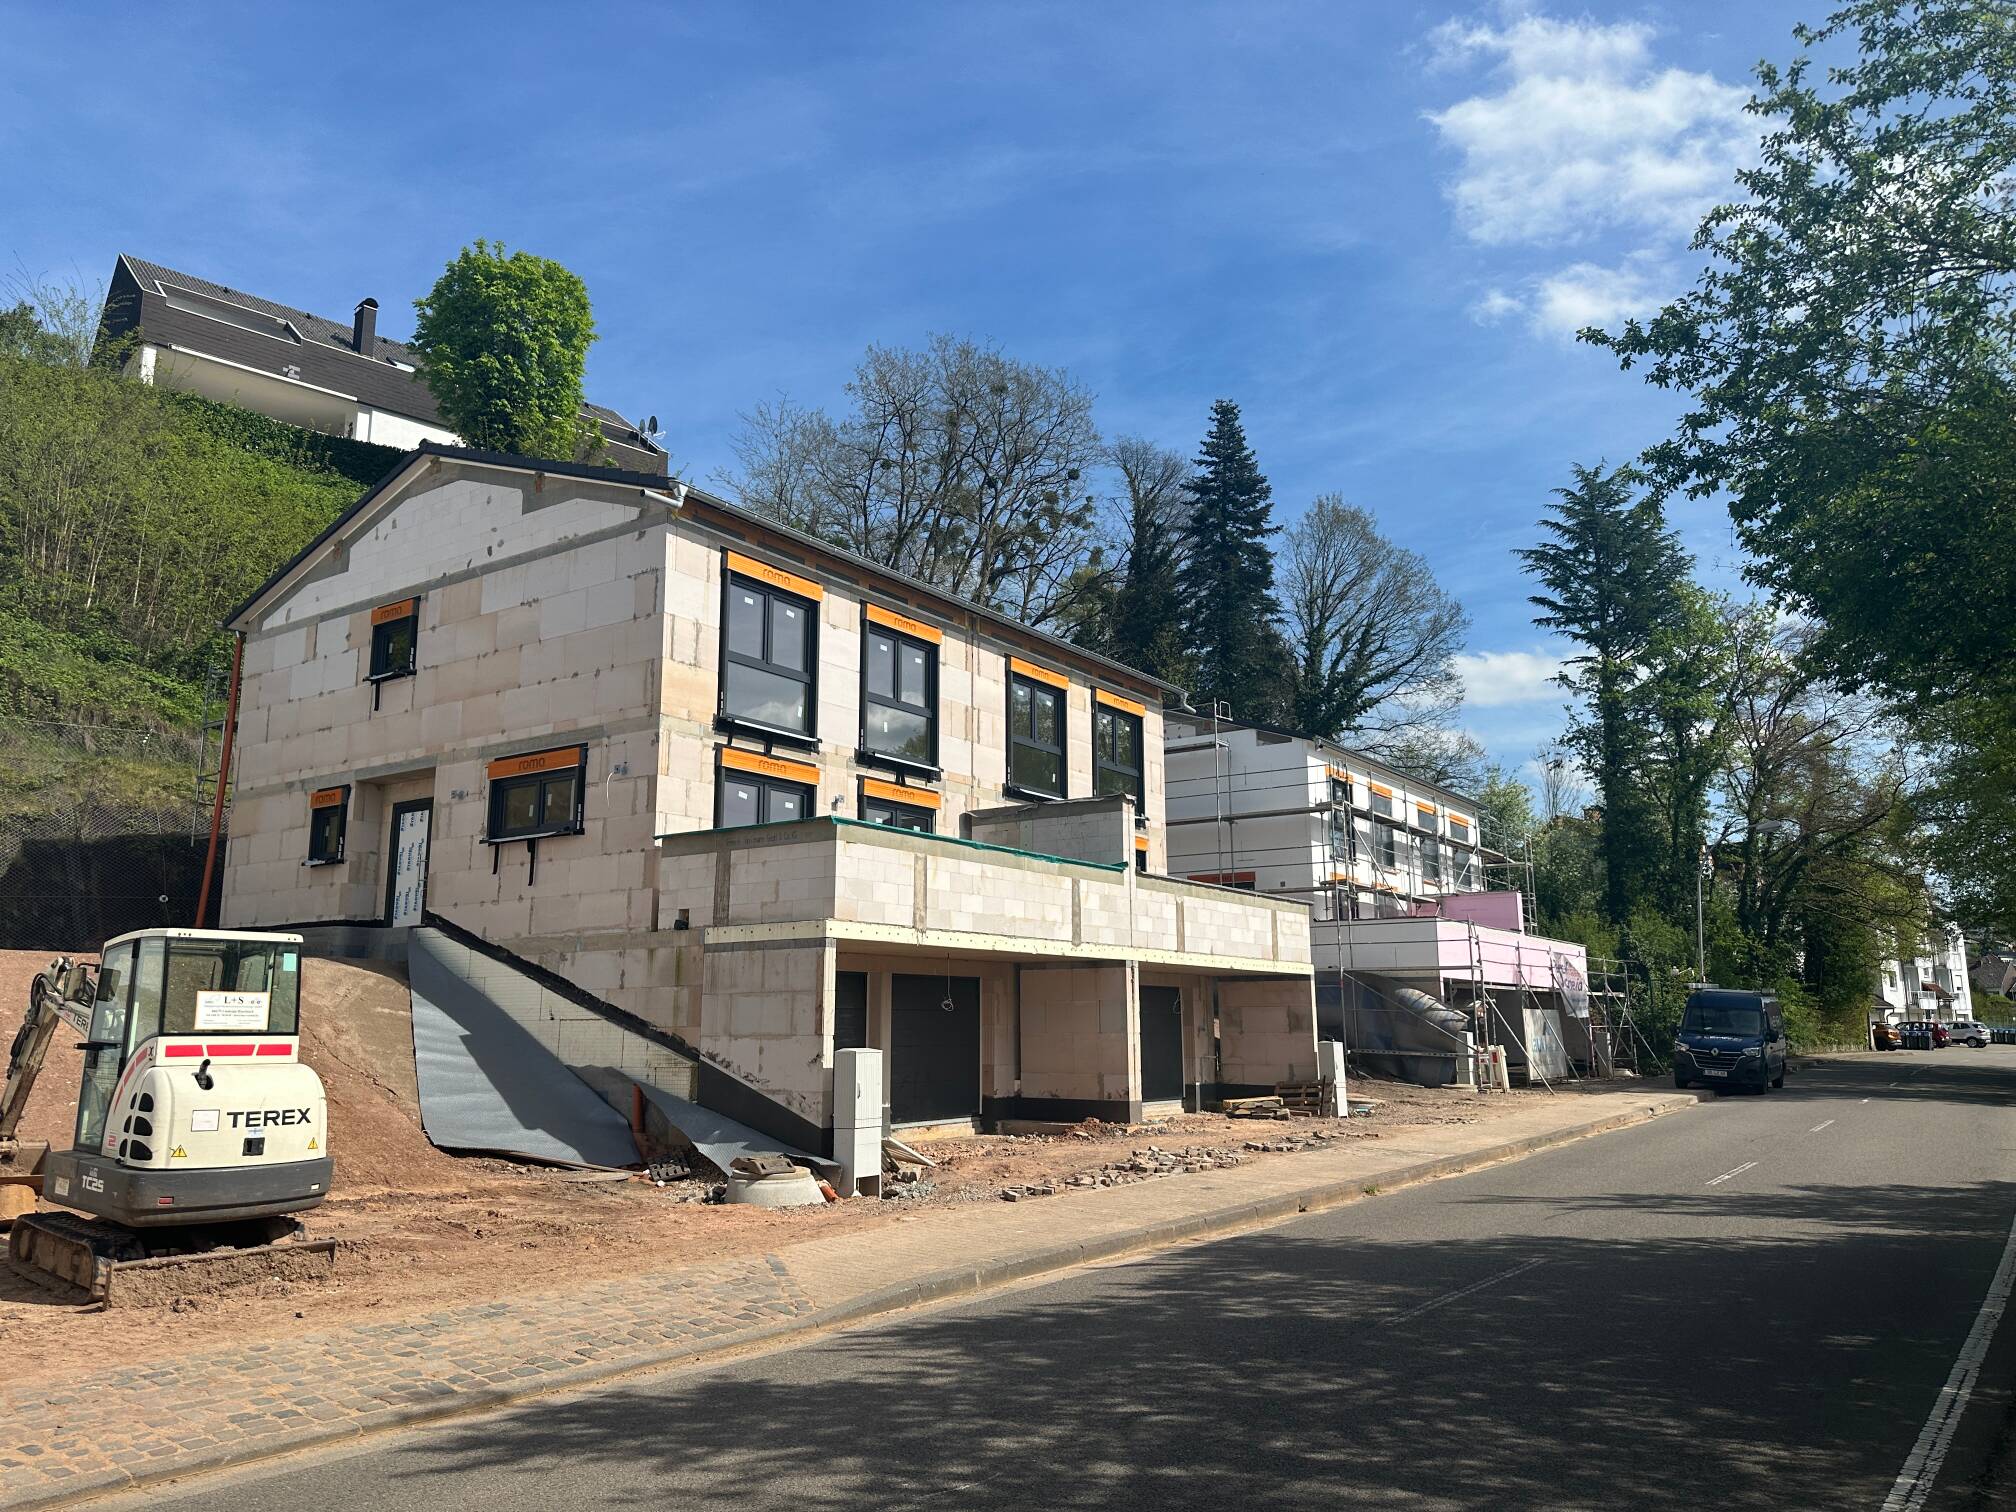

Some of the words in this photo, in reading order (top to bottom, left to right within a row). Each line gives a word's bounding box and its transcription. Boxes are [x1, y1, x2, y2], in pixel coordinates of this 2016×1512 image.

[762, 568, 791, 586] roma
[894, 617, 917, 632] roma
[518, 758, 545, 771] roma
[758, 759, 787, 775] roma
[226, 1107, 312, 1128] TEREX
